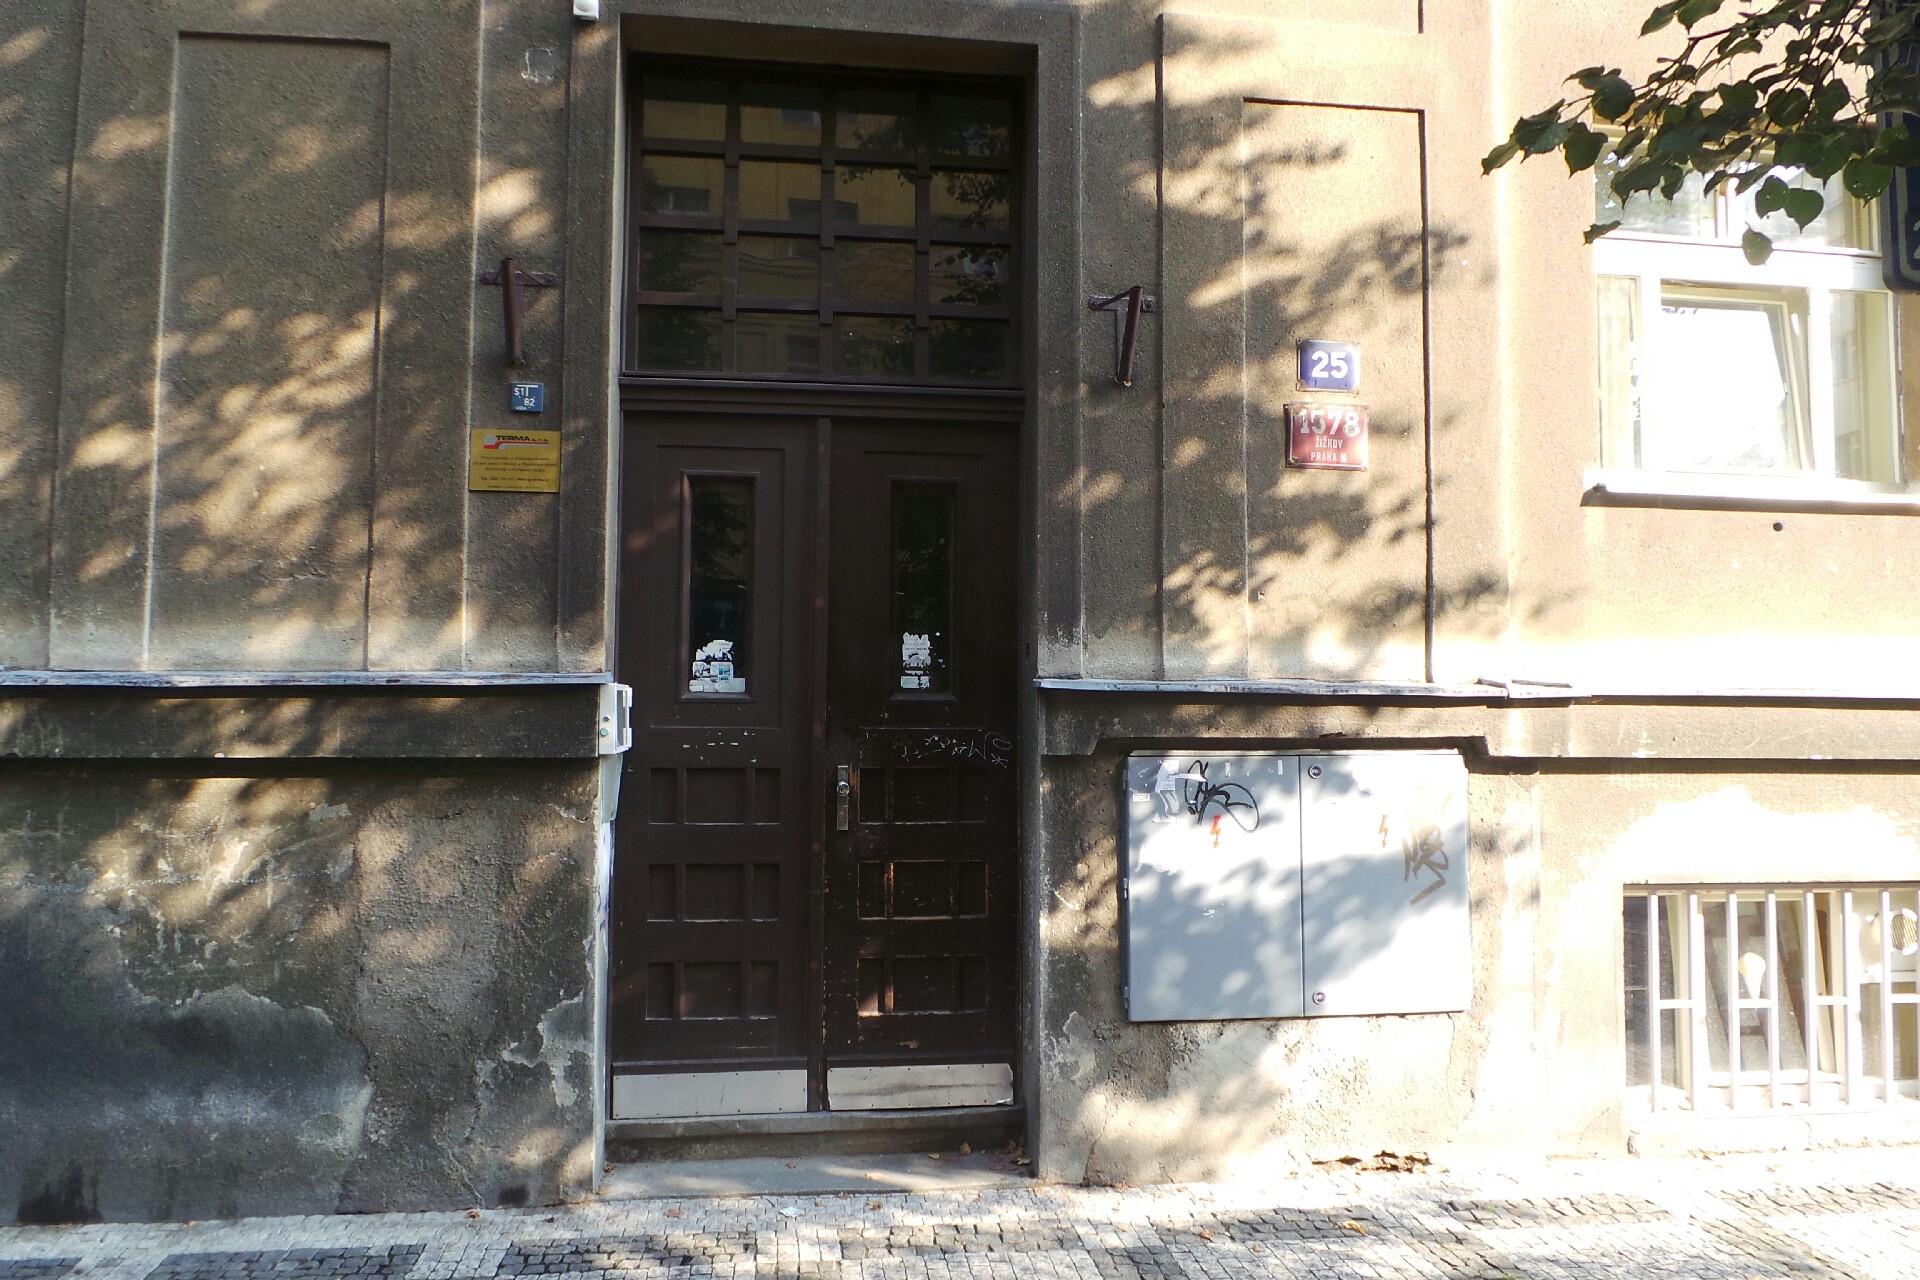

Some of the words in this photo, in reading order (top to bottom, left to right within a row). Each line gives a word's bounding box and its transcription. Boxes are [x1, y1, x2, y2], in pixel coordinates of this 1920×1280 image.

[1311, 351, 1348, 378] 25
[1299, 409, 1360, 437] 1578
[1315, 436, 1344, 449] ŽIŽKOV
[1310, 451, 1338, 462] PRAHA
